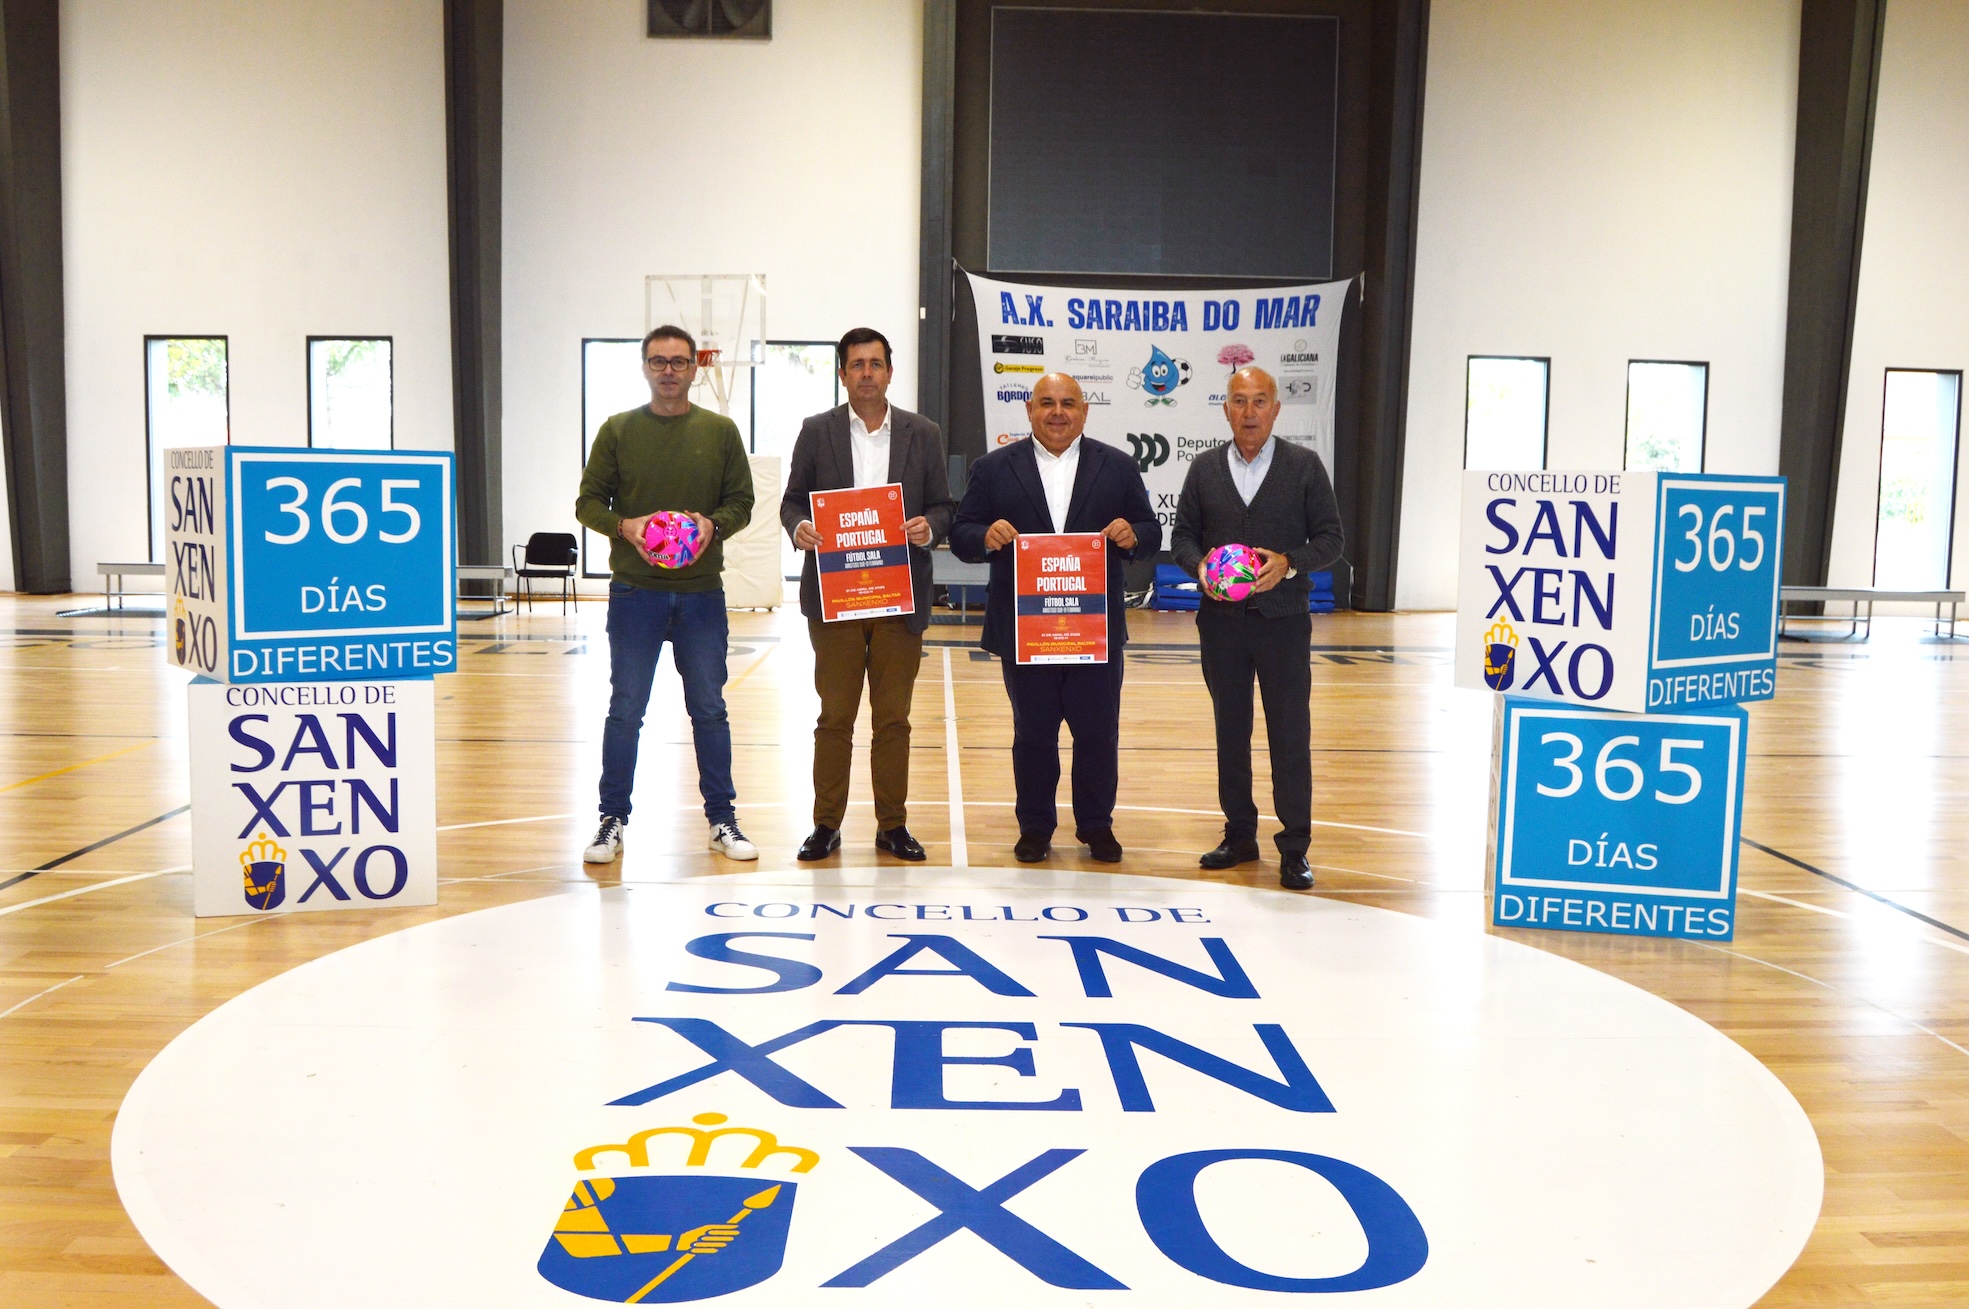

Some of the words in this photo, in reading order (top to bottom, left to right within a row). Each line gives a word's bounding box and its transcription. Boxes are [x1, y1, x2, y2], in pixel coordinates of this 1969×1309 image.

[1000, 291, 1053, 328] A.X.
[1067, 298, 1188, 332] SARAIBA
[1203, 300, 1239, 331] DO
[1254, 294, 1321, 330] MAR
[1286, 353, 1318, 363] GALICIANA
[999, 383, 1029, 391] TALLERES
[171, 450, 203, 470] CONCELLO
[204, 450, 213, 469] DE
[1488, 473, 1588, 493] CONCELLO
[1595, 474, 1621, 494] DE
[171, 476, 214, 535] SAN
[264, 477, 421, 545] 365
[839, 508, 879, 528] ESPAÑA
[836, 529, 887, 548] PORTUGAL
[1485, 498, 1618, 560] SAN
[1675, 504, 1767, 573] 365
[172, 541, 215, 602] XEN
[846, 551, 866, 563] FÚTBOL
[866, 550, 881, 561] SALA
[1041, 554, 1081, 572] ESPAÑA
[301, 577, 387, 614] DÍAS
[846, 598, 888, 608] SANXENXO
[1036, 576, 1087, 592] PORTUGAL
[1044, 596, 1064, 607] FÚTBOL
[1065, 597, 1079, 607] SALA
[1484, 565, 1615, 631] XEN
[188, 611, 218, 673] XO
[1690, 606, 1740, 642] DÍAS
[233, 639, 453, 677] DIFERENTES
[1522, 636, 1614, 700] XO
[226, 686, 356, 707] CONCELLO
[366, 685, 396, 705] DE
[1649, 668, 1774, 707] DIFERENTES
[228, 711, 397, 772] SAN
[1536, 732, 1705, 805] 365
[232, 778, 398, 839] XEN
[1568, 833, 1658, 871] DÍAS
[297, 844, 409, 904] XO
[704, 901, 1089, 923] CONCELLO
[1106, 905, 1211, 924] DE
[1500, 894, 1730, 936] DIFERENTES
[665, 932, 1262, 1000] SAN
[603, 1016, 1338, 1113] XEN
[817, 1146, 1430, 1293] XO
